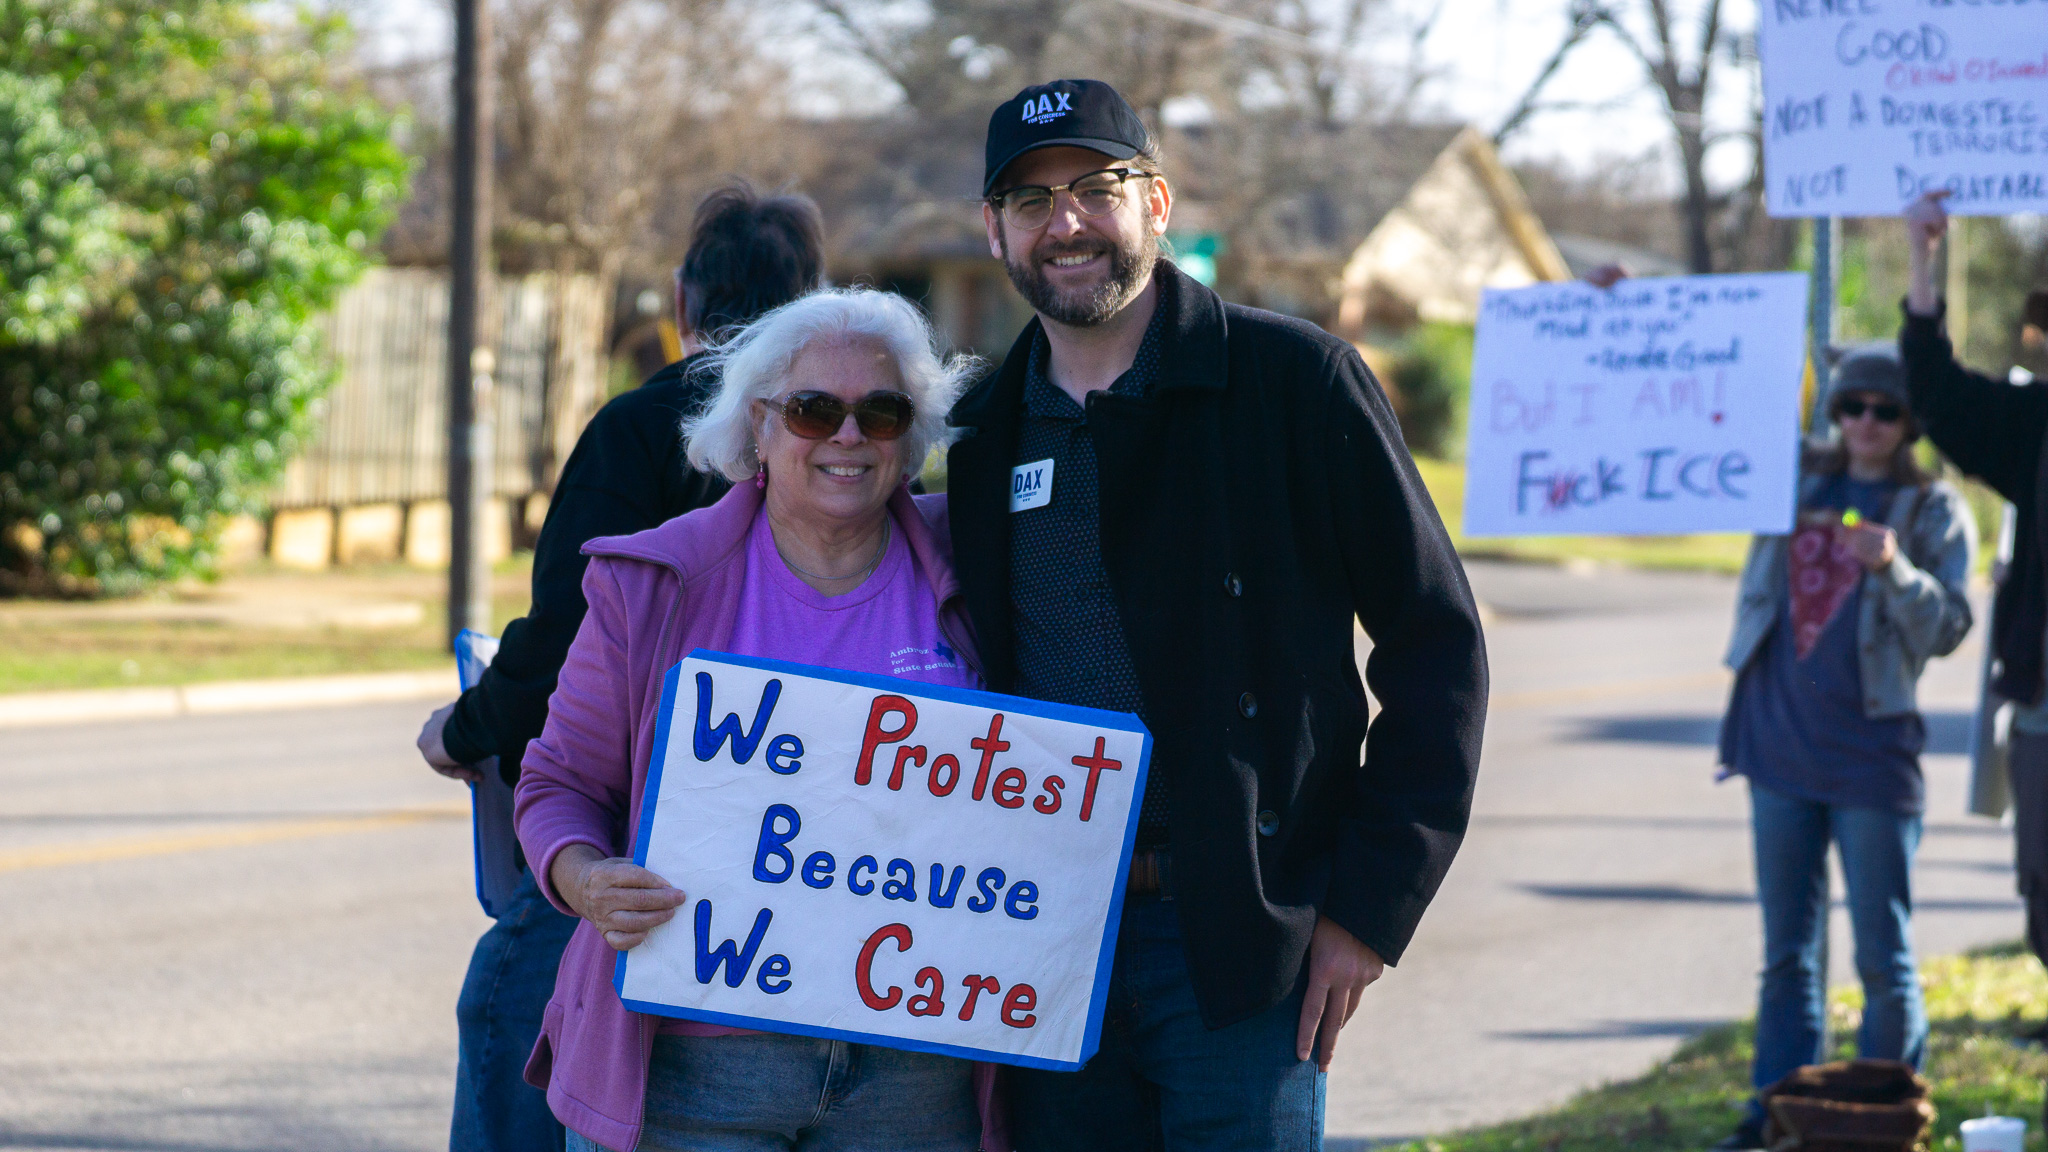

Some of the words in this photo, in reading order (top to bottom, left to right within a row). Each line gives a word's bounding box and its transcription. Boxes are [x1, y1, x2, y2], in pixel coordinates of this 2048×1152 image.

[1835, 20, 1948, 67] GOOD
[1022, 92, 1072, 121] DAX
[1773, 91, 1828, 140] NOT
[1880, 97, 2038, 128] DOMESTIC
[1784, 164, 1845, 207] NOT
[1489, 377, 1557, 435] But
[1567, 382, 1603, 427] I
[1013, 468, 1043, 495] DAX
[890, 646, 929, 658] Ambroz
[893, 665, 921, 674] State
[692, 671, 805, 776] We
[853, 694, 1123, 823] Protest
[752, 803, 1040, 921] Because
[693, 898, 793, 995] We
[854, 922, 1038, 1029] Care
